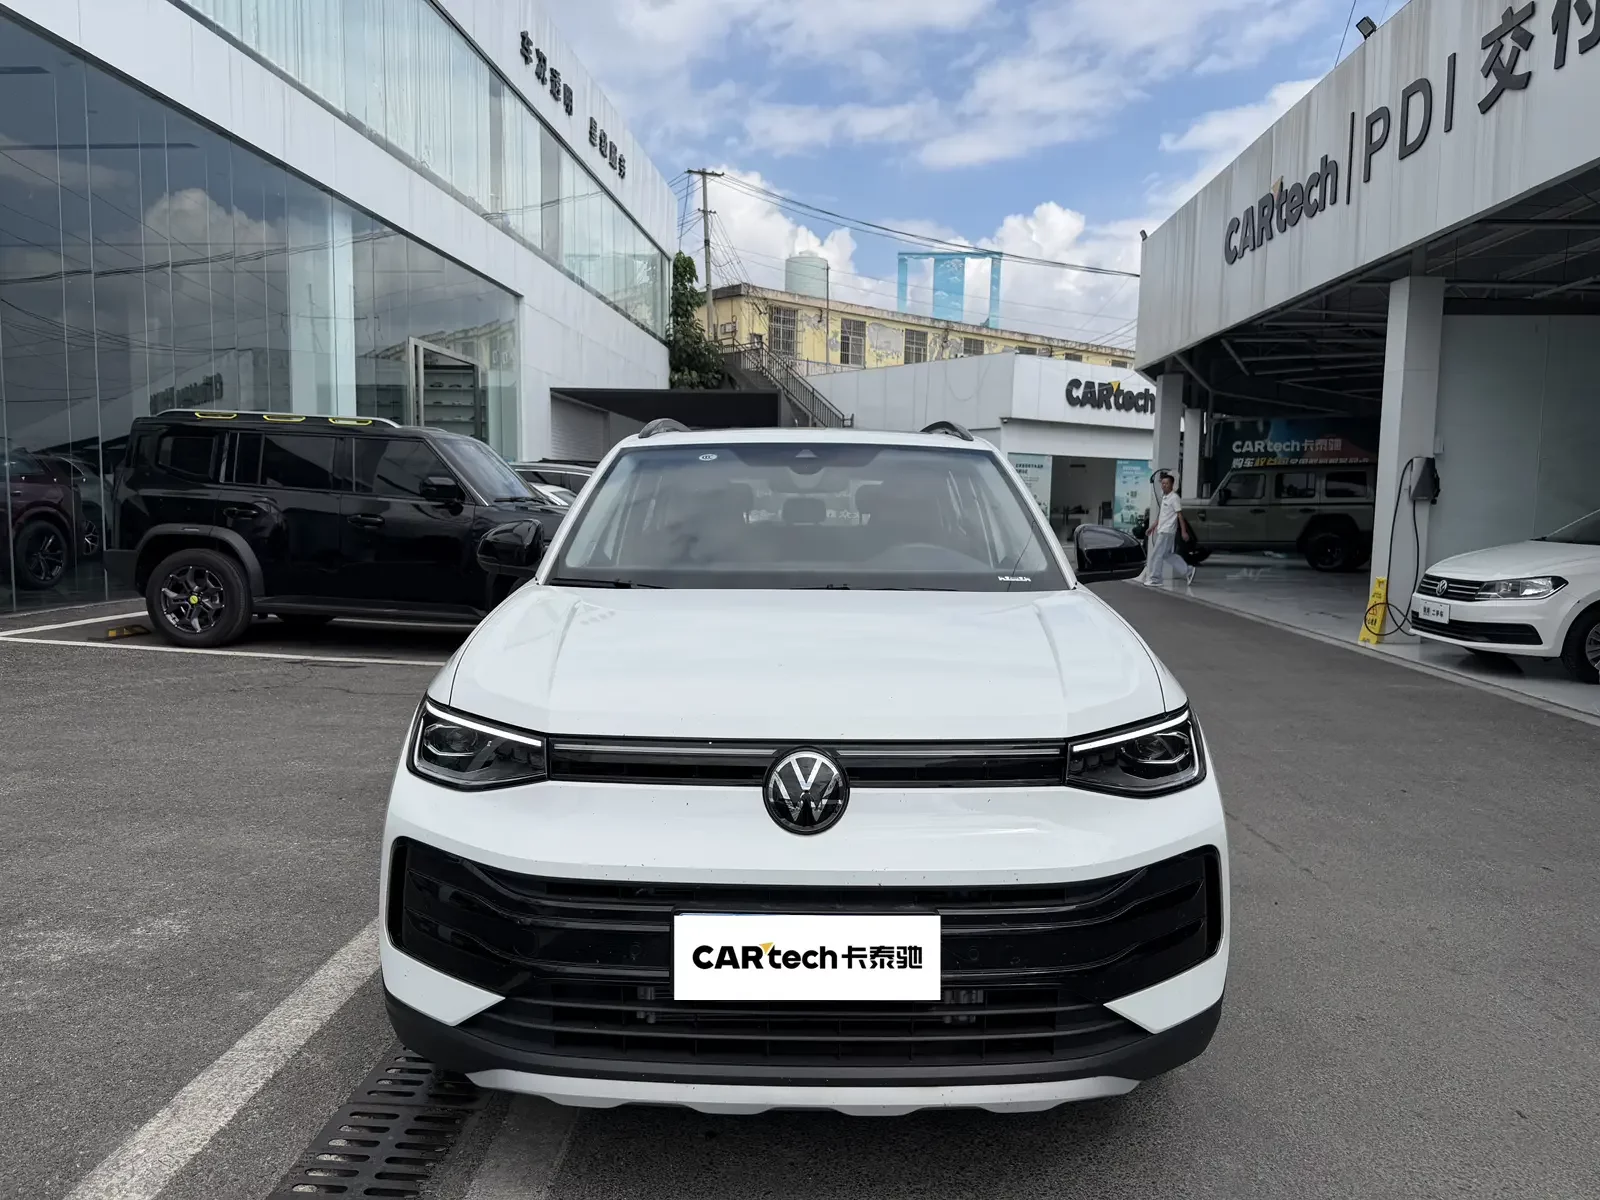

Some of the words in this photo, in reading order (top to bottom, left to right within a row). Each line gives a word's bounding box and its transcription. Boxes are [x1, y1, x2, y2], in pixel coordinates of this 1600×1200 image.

[1224, 154, 1338, 265] CARtech
[1065, 378, 1156, 414] CARtech
[1232, 440, 1299, 453] CARtech
